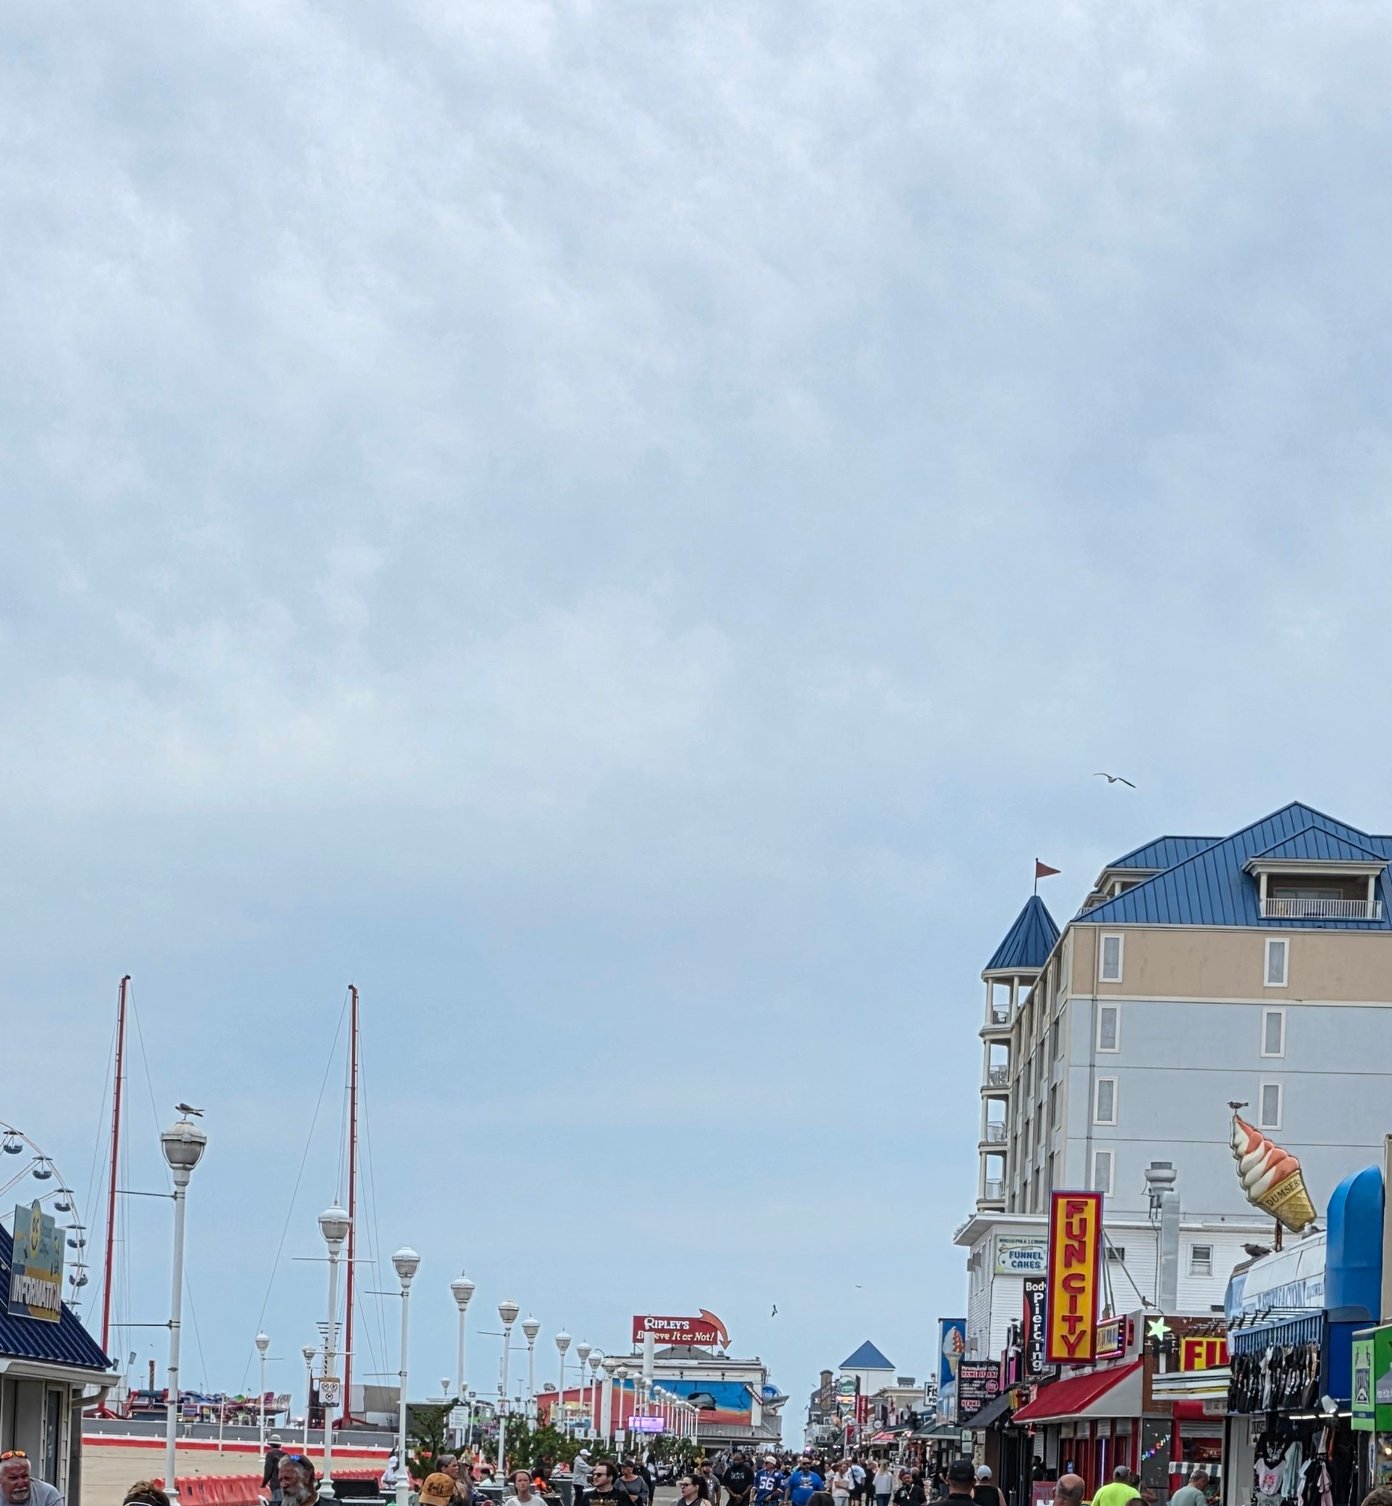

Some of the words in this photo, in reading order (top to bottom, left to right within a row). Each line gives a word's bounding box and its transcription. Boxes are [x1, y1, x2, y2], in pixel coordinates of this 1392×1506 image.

[1064, 1200, 1088, 1268] FUN
[1008, 1250, 1044, 1260] FUNNEL
[1011, 1260, 1041, 1269] CAKES
[1061, 1272, 1087, 1356] CITY
[671, 1331, 681, 1340] It
[694, 1332, 715, 1341] Not!
[1032, 1292, 1044, 1371] Piercing
[760, 1476, 775, 1491] 56
